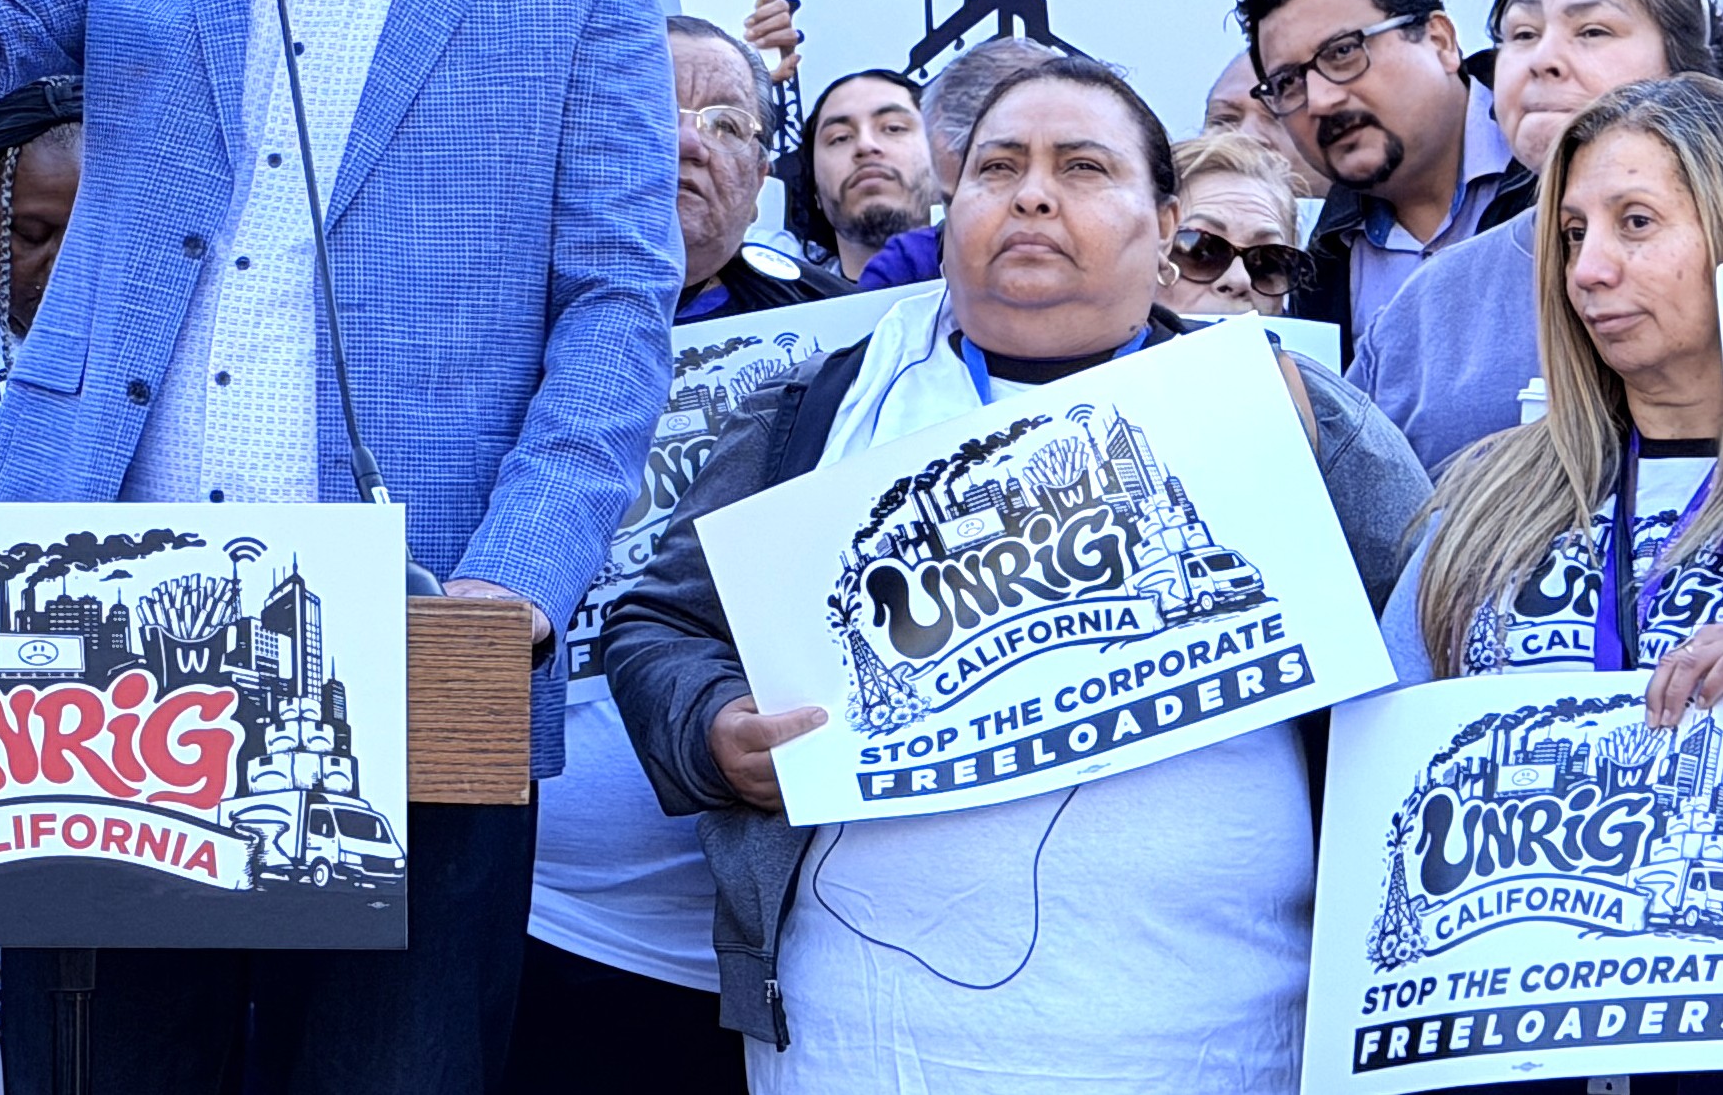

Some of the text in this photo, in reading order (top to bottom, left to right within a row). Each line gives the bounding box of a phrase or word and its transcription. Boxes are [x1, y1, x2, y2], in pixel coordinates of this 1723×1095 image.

[176, 647, 210, 674] W
[935, 608, 1140, 695] CALIFORNIA
[859, 612, 1285, 765] STOP THE CORPORATE
[870, 652, 1305, 796] FREELOADERS
[1435, 886, 1623, 940] CALIFORNIA
[1361, 976, 1437, 1016] STOP
[1447, 967, 1511, 1001] THE
[1359, 1000, 1723, 1065] FREELOADER
